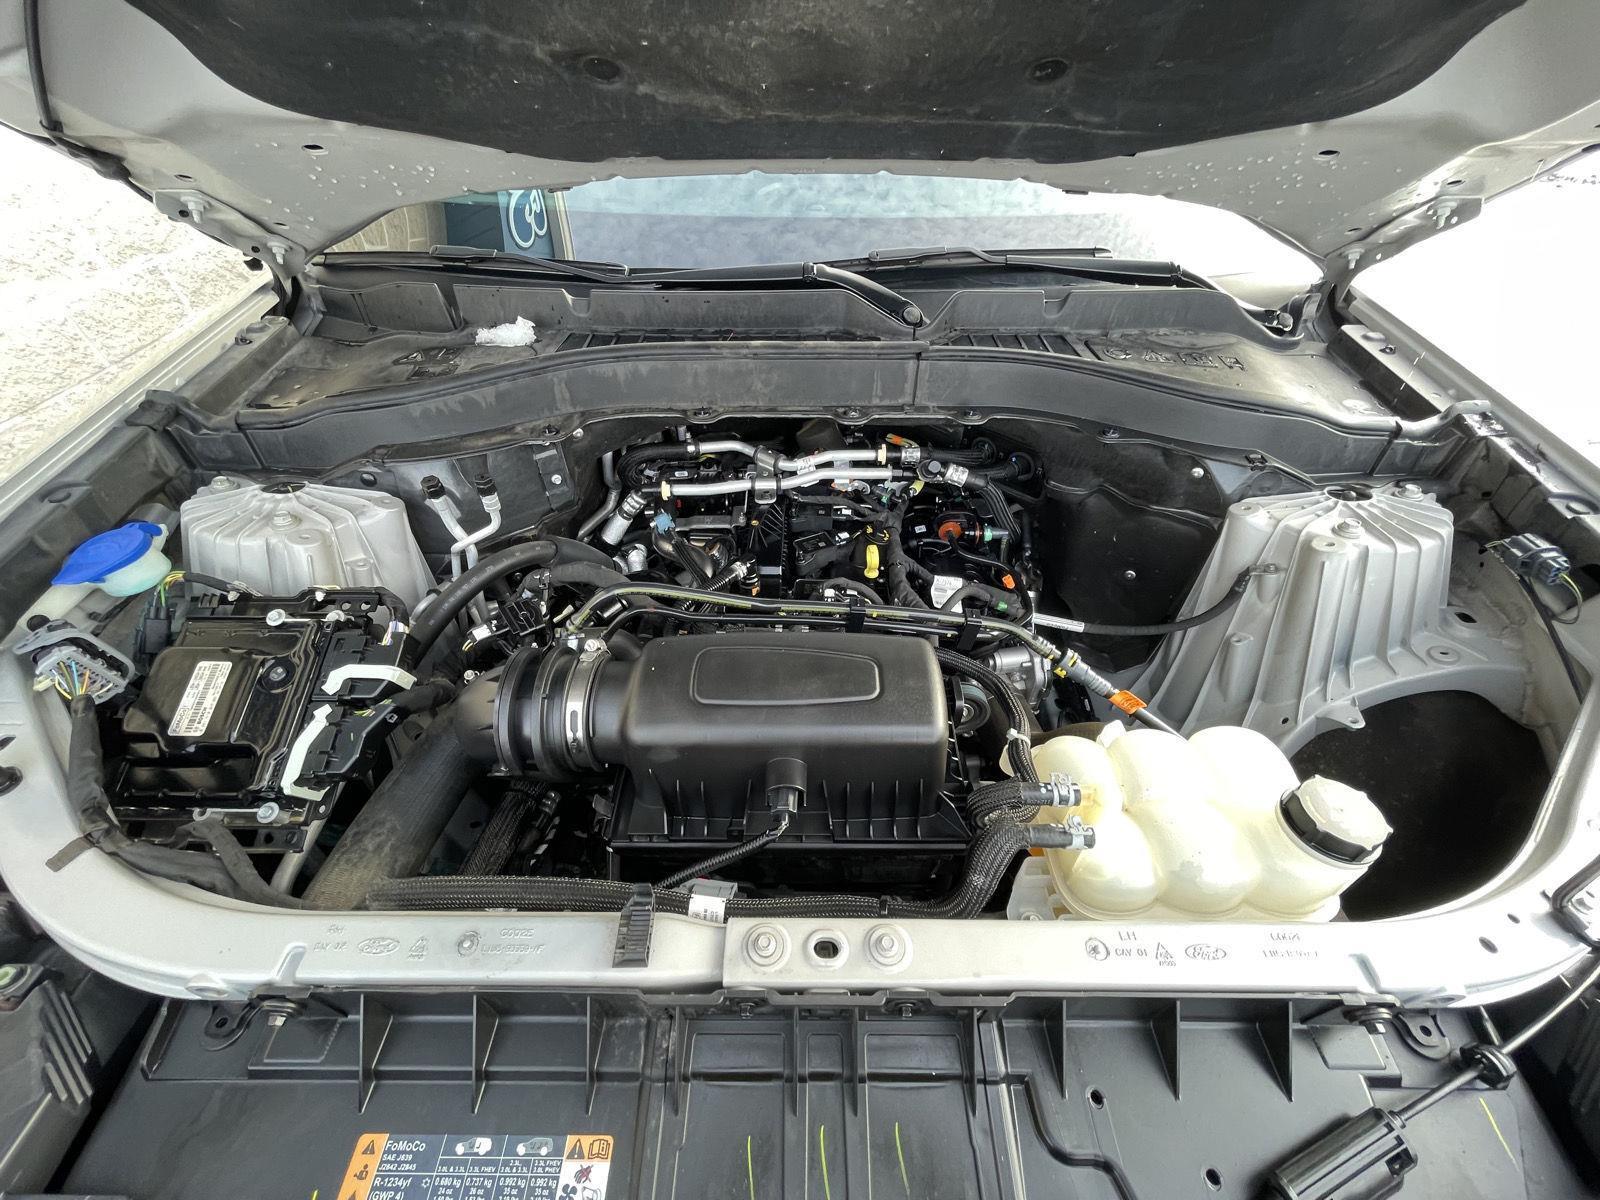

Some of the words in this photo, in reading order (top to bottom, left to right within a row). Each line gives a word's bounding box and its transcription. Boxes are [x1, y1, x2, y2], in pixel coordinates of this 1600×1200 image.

[385, 1140, 426, 1151] FoMoCo
[373, 1177, 412, 1189] R-1234yf
[453, 1177, 461, 1188] kg
[466, 1177, 483, 1186] 0.737
[484, 1177, 492, 1188] kg
[499, 1177, 517, 1186] 0.992
[517, 1178, 526, 1188] kg
[531, 1178, 548, 1186] 0.992
[548, 1178, 557, 1188] kg
[369, 1191, 395, 1200] (GWP
[395, 1191, 404, 1200] 4)
